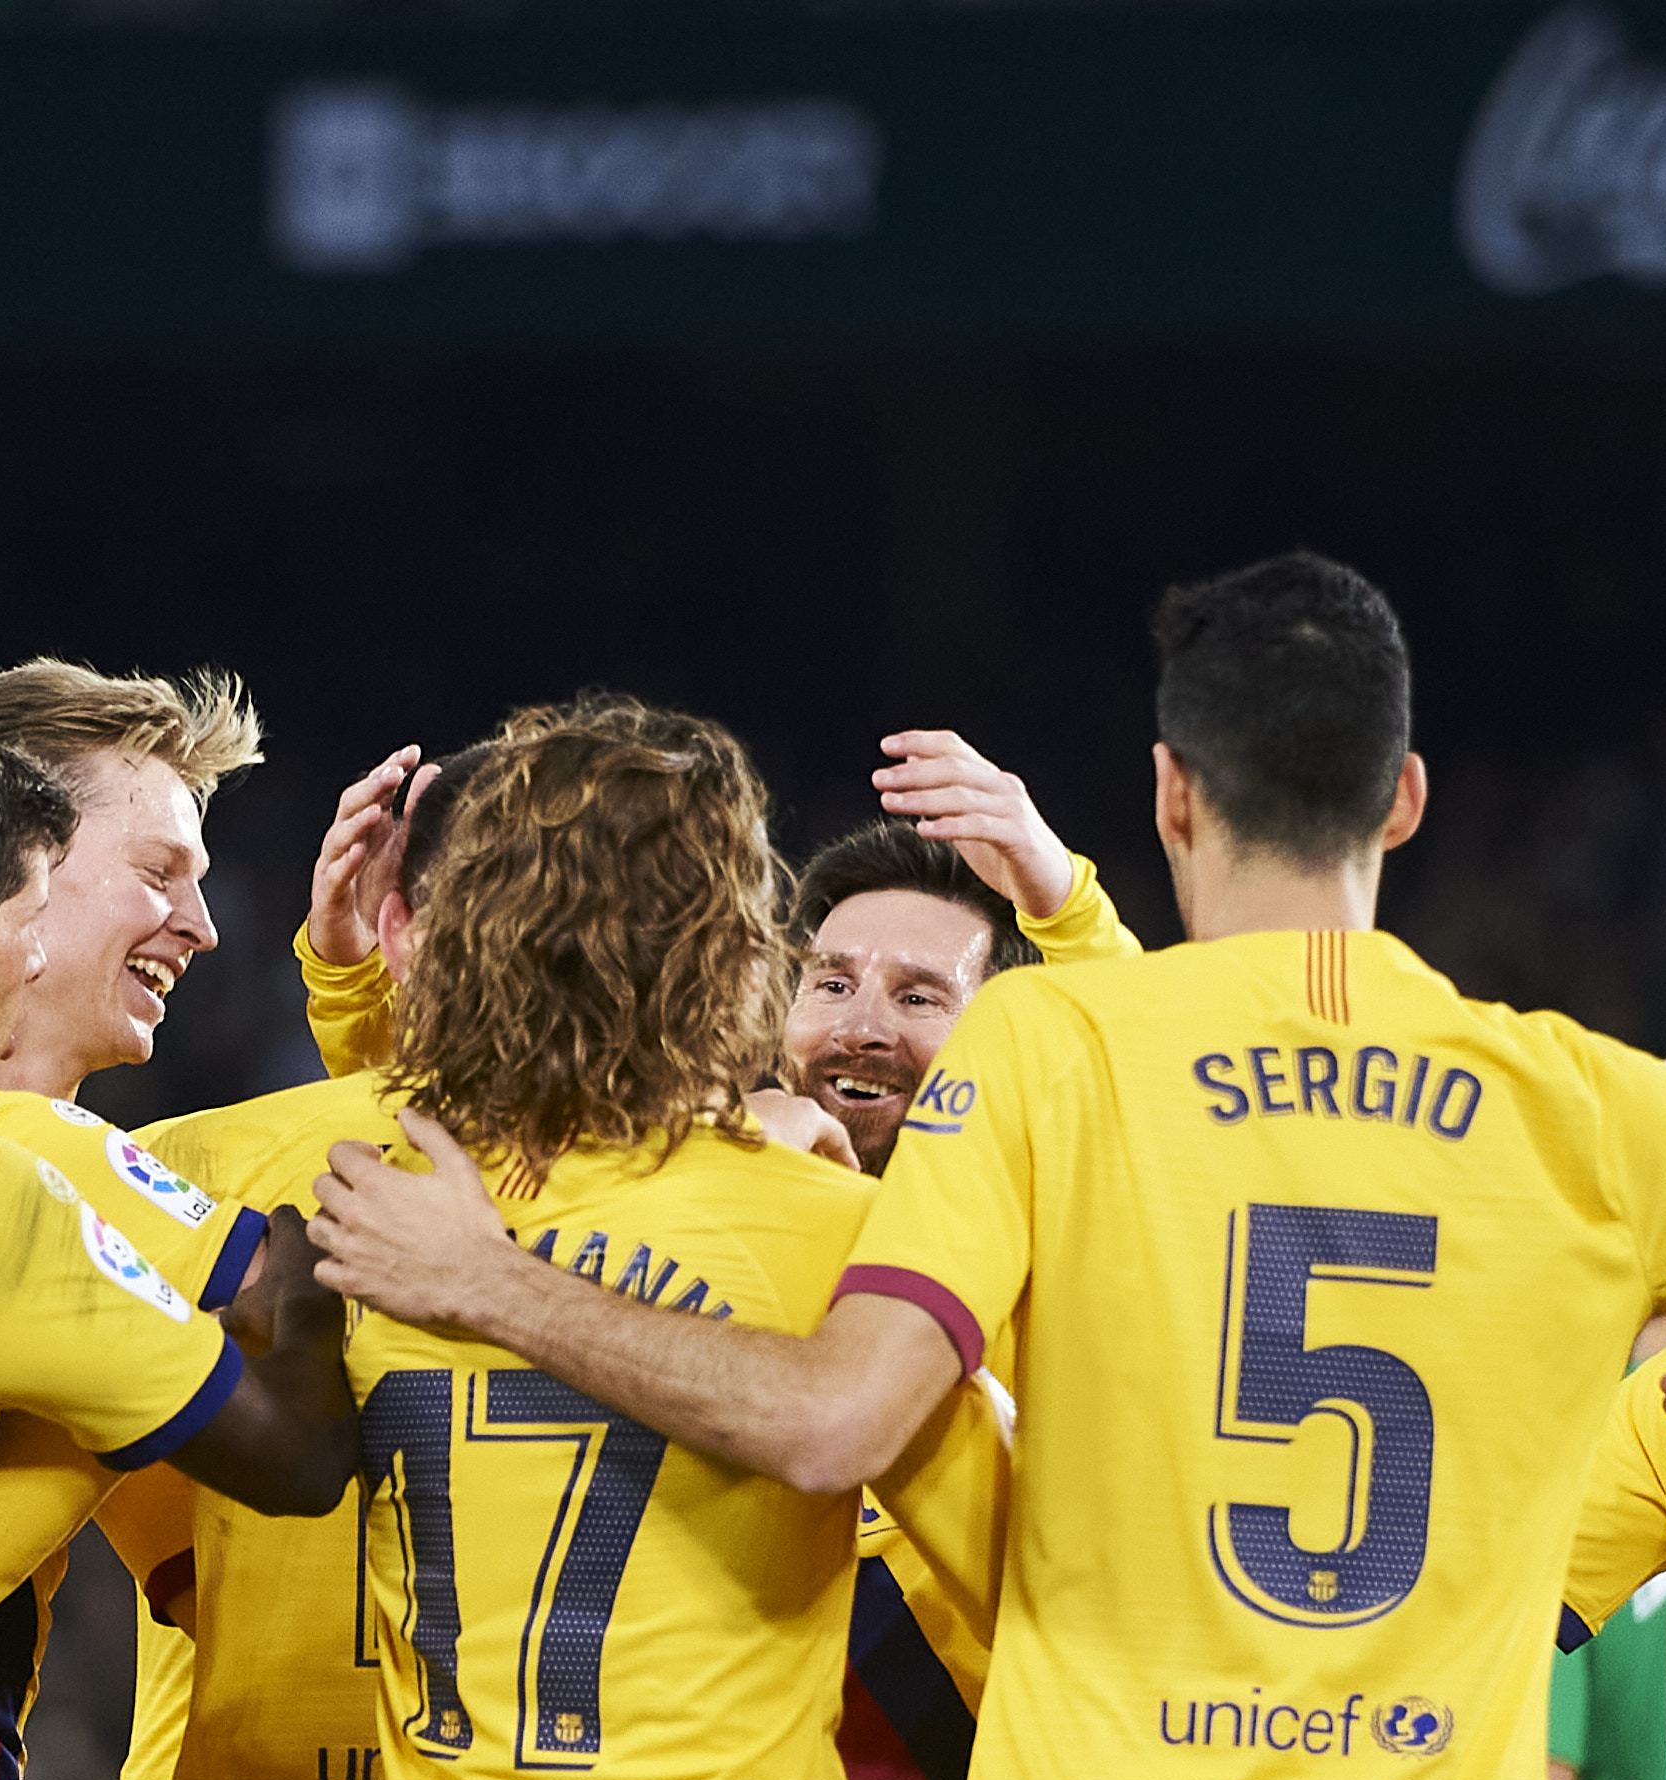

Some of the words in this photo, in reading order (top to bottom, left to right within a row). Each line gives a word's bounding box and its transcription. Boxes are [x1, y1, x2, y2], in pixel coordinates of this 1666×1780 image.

[1193, 1044, 1484, 1142] SERGIO
[1207, 1203, 1439, 1629] 5
[358, 1368, 666, 1770] 17
[1160, 1688, 1365, 1757] unicef
